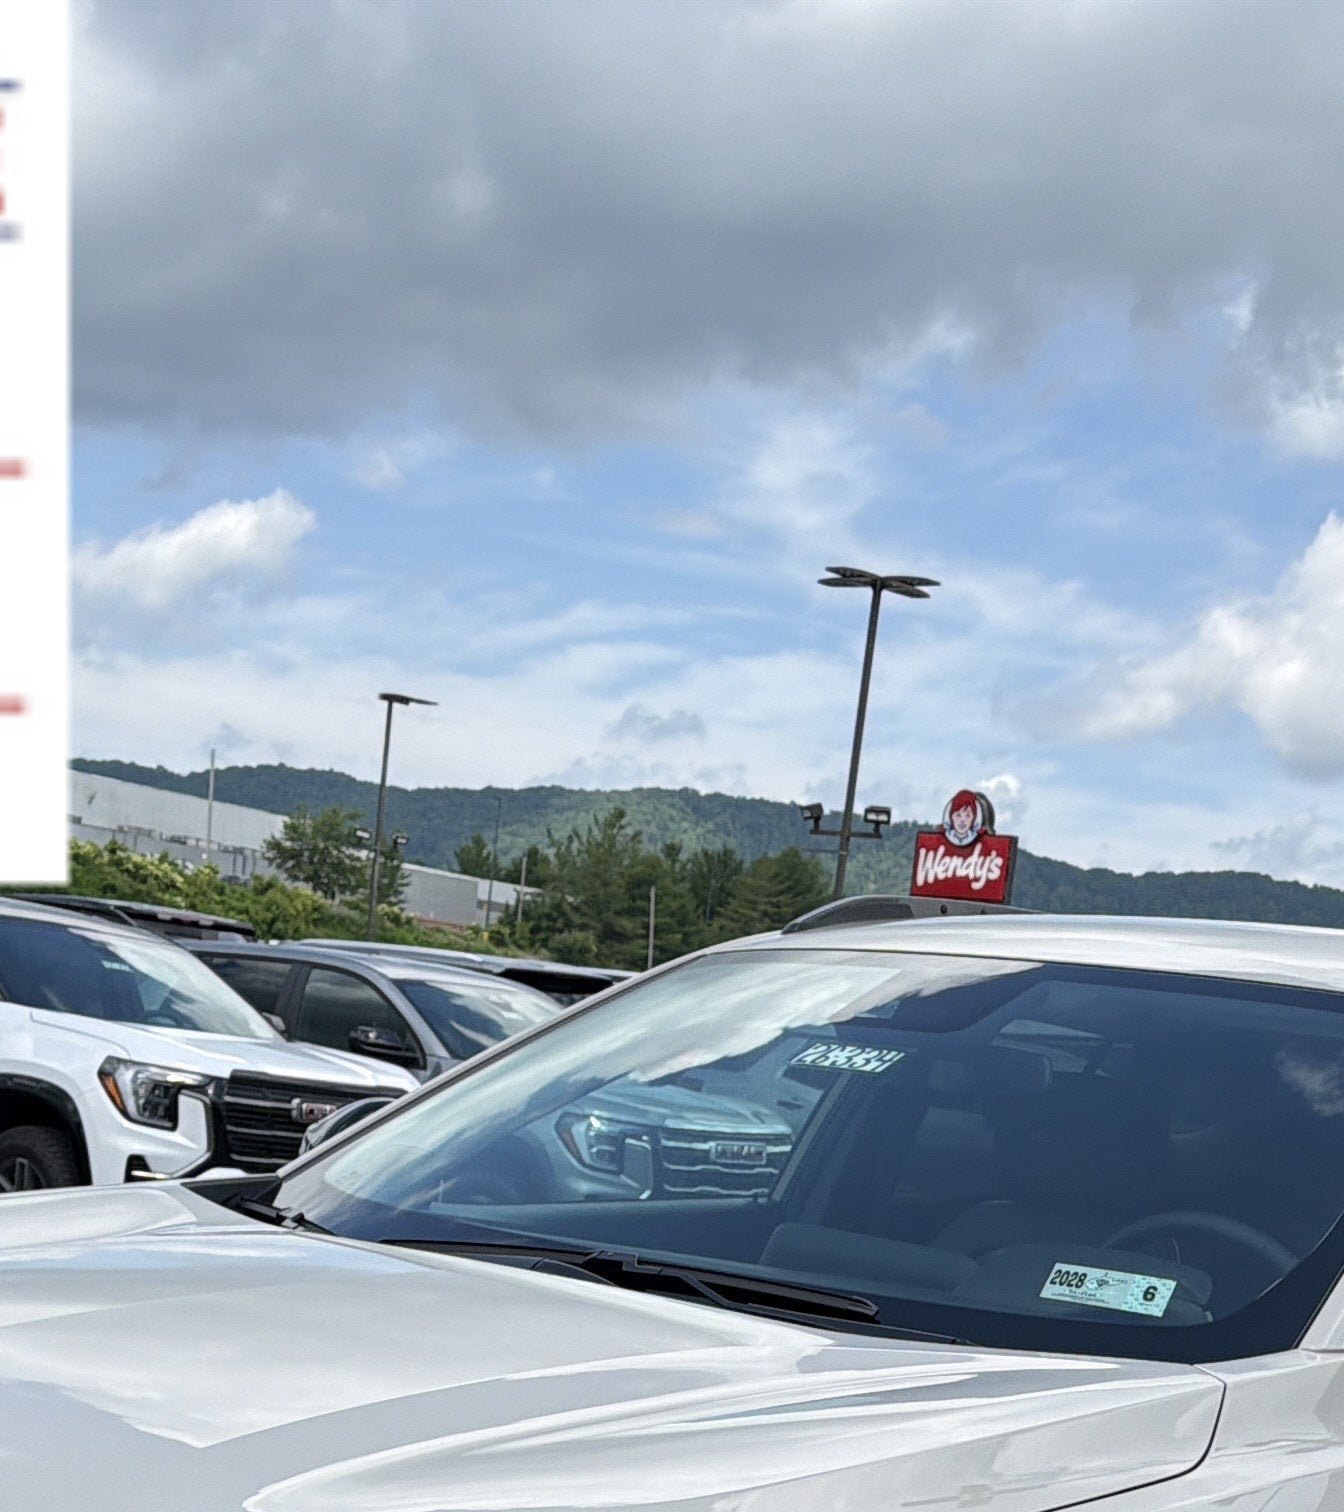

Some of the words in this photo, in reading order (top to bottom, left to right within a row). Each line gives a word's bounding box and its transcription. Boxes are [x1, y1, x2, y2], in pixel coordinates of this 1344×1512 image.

[916, 842, 1004, 890] Wendy's
[1049, 1269, 1088, 1289] 2028
[1142, 1285, 1158, 1302] 6
